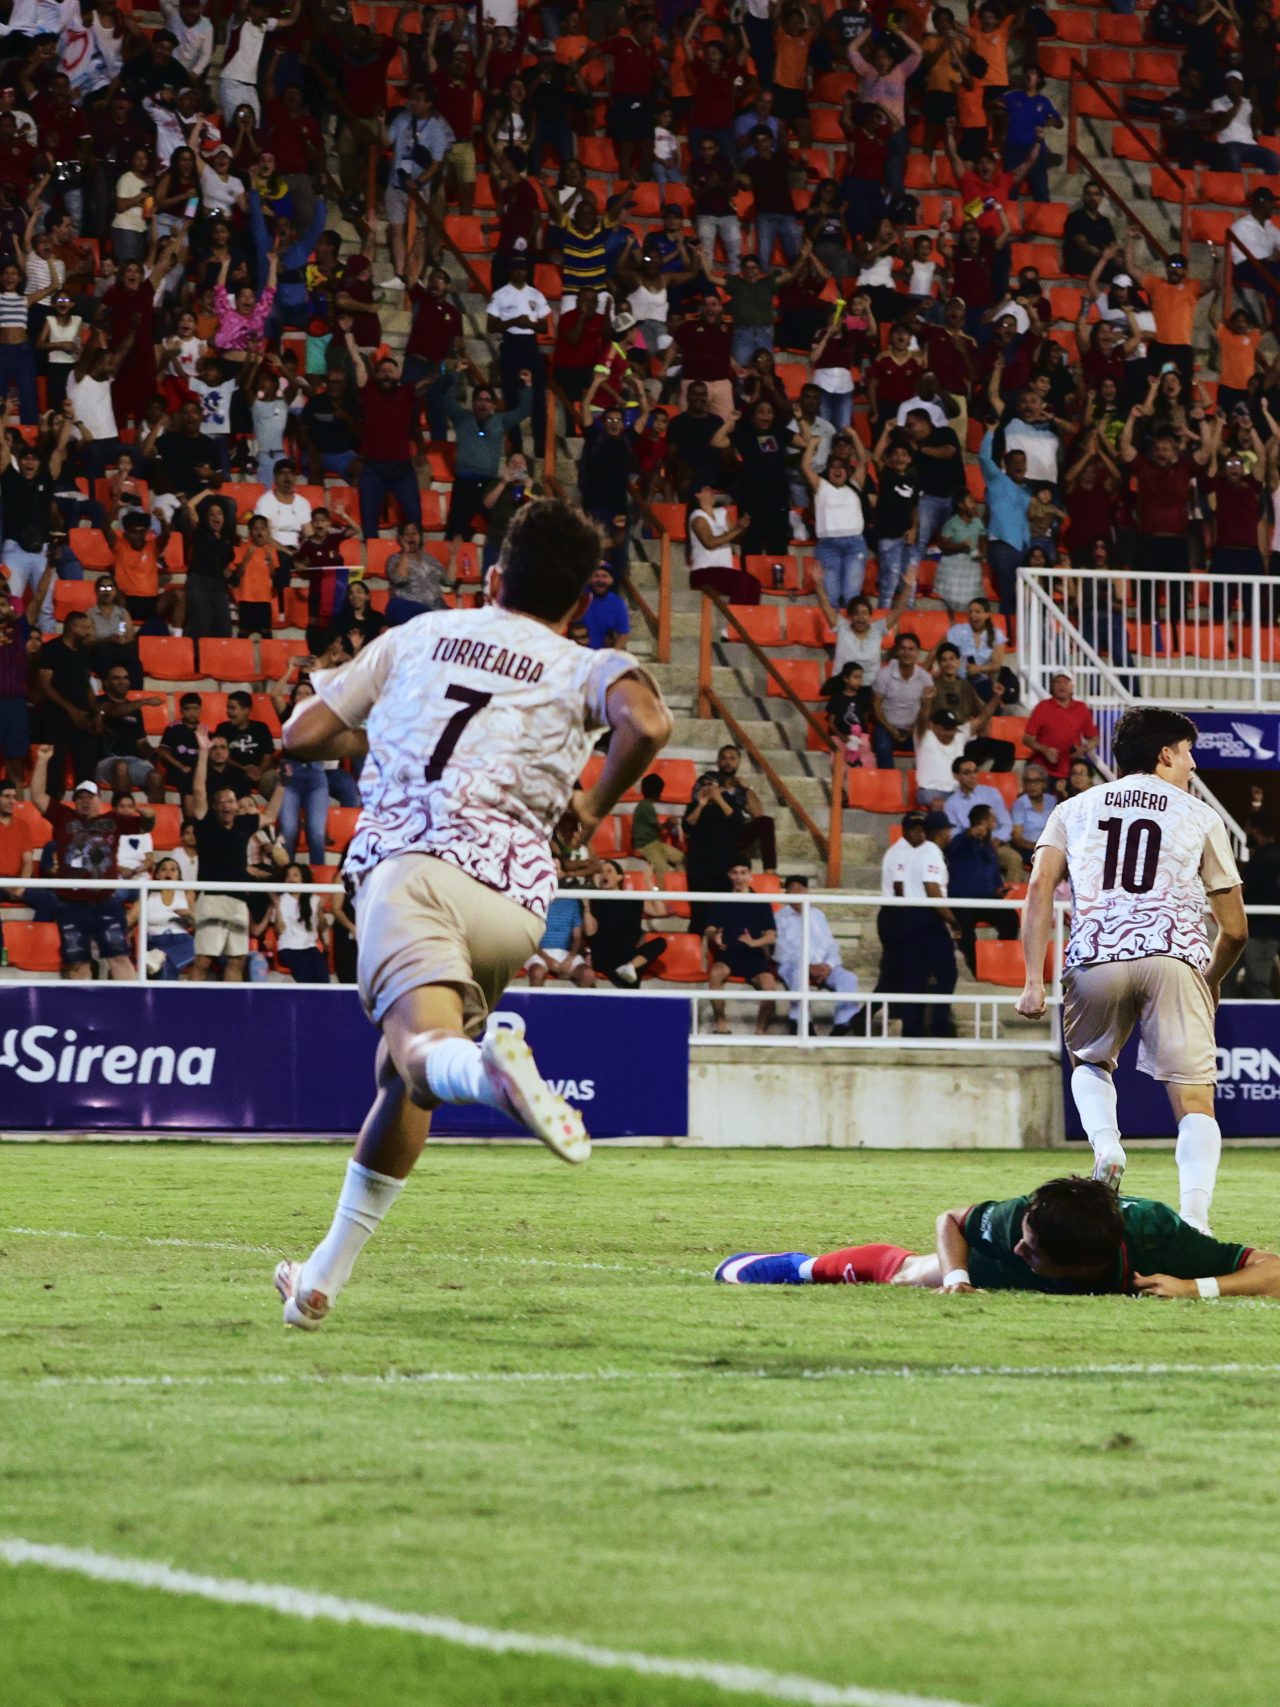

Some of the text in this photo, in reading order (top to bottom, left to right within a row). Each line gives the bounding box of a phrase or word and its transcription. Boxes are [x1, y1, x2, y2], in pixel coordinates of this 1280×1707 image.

[432, 637, 545, 683] TORREALBA
[424, 684, 493, 782] 7
[1104, 790, 1168, 812] CARRERO
[1098, 817, 1162, 894] 10
[15, 1025, 216, 1085] Sirena
[546, 1079, 595, 1101] VAS
[1216, 1083, 1236, 1100] TS
